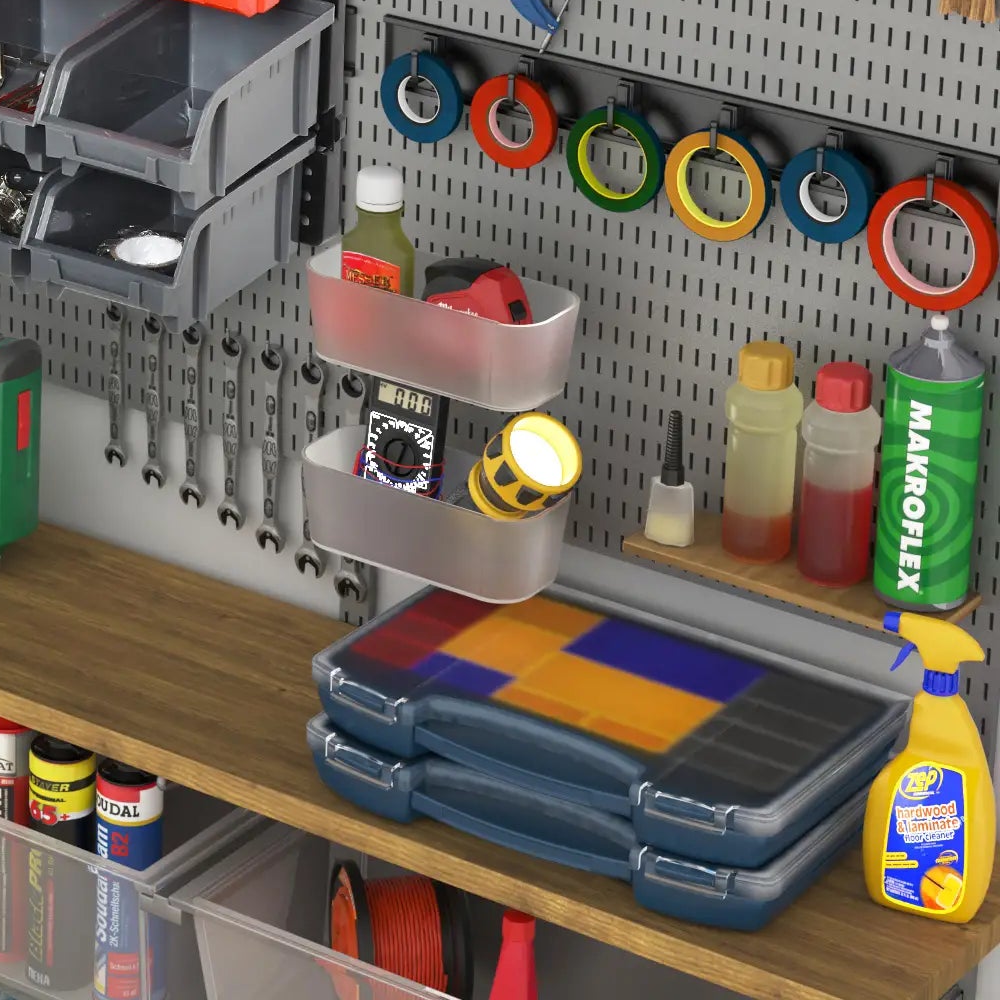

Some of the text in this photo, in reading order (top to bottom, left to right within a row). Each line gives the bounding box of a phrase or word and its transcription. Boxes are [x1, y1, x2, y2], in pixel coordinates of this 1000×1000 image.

[897, 399, 932, 593] MAKROFLEX
[896, 801, 956, 819] hardwood
[896, 817, 959, 834] & laminate
[110, 831, 129, 857] B2
[904, 831, 954, 842] floor cleaner
